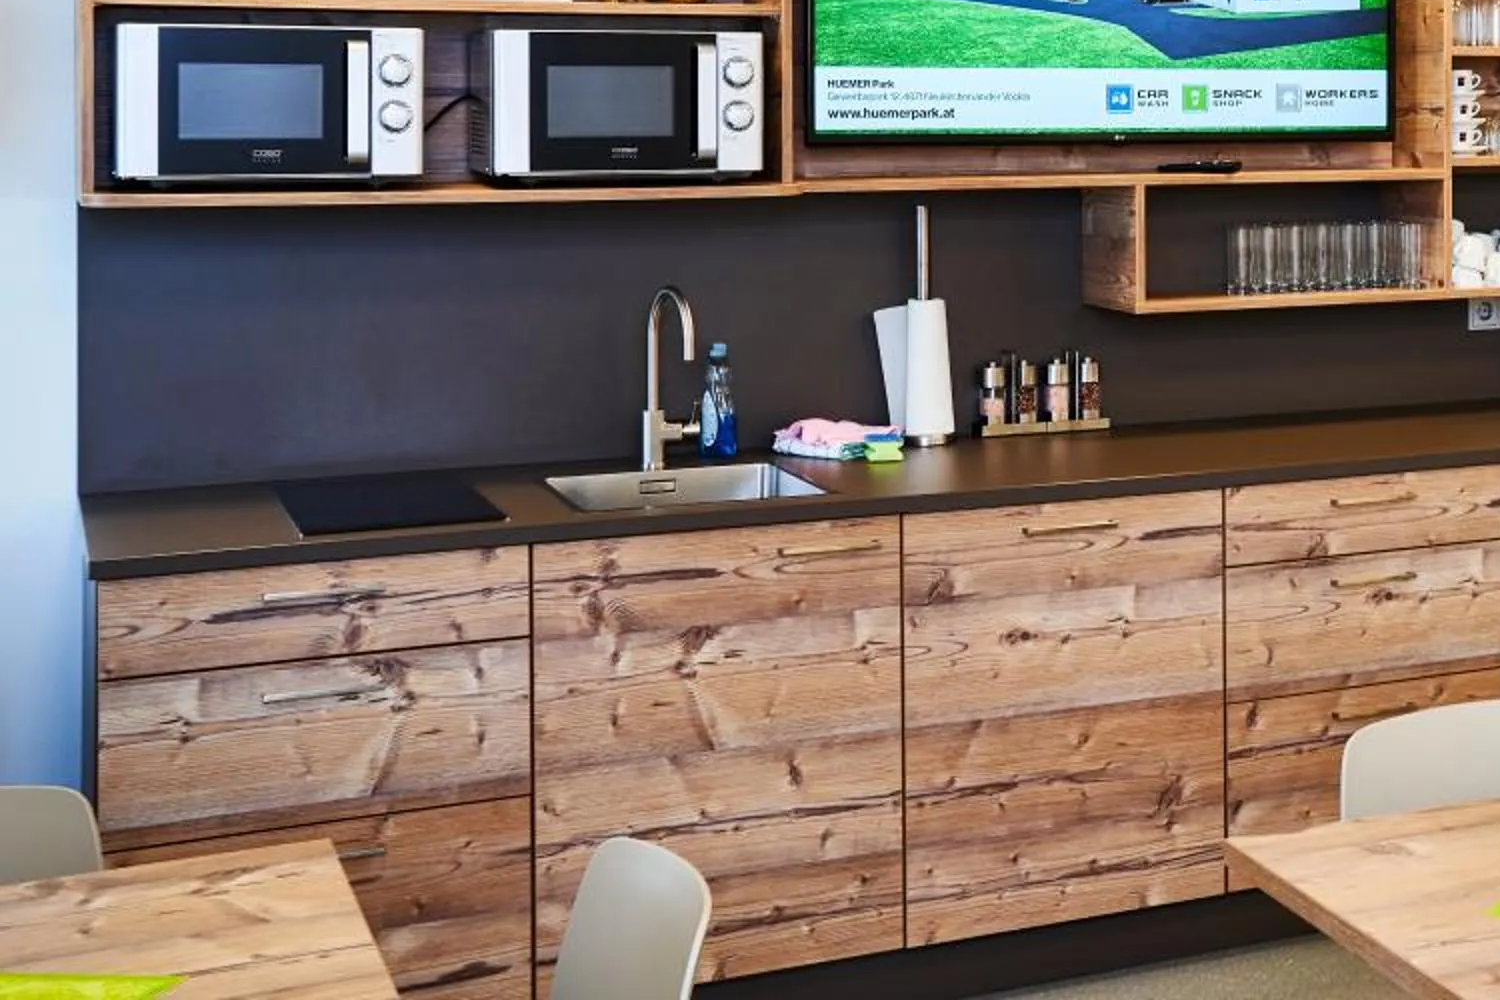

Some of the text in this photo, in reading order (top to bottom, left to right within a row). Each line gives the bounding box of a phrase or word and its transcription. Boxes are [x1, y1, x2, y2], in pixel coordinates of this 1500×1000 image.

[872, 79, 895, 89] Park
[1137, 89, 1169, 99] CAR
[1212, 89, 1263, 99] SNACK
[1305, 89, 1379, 99] WORKERS
[827, 108, 955, 120] www.huemerpark.at
